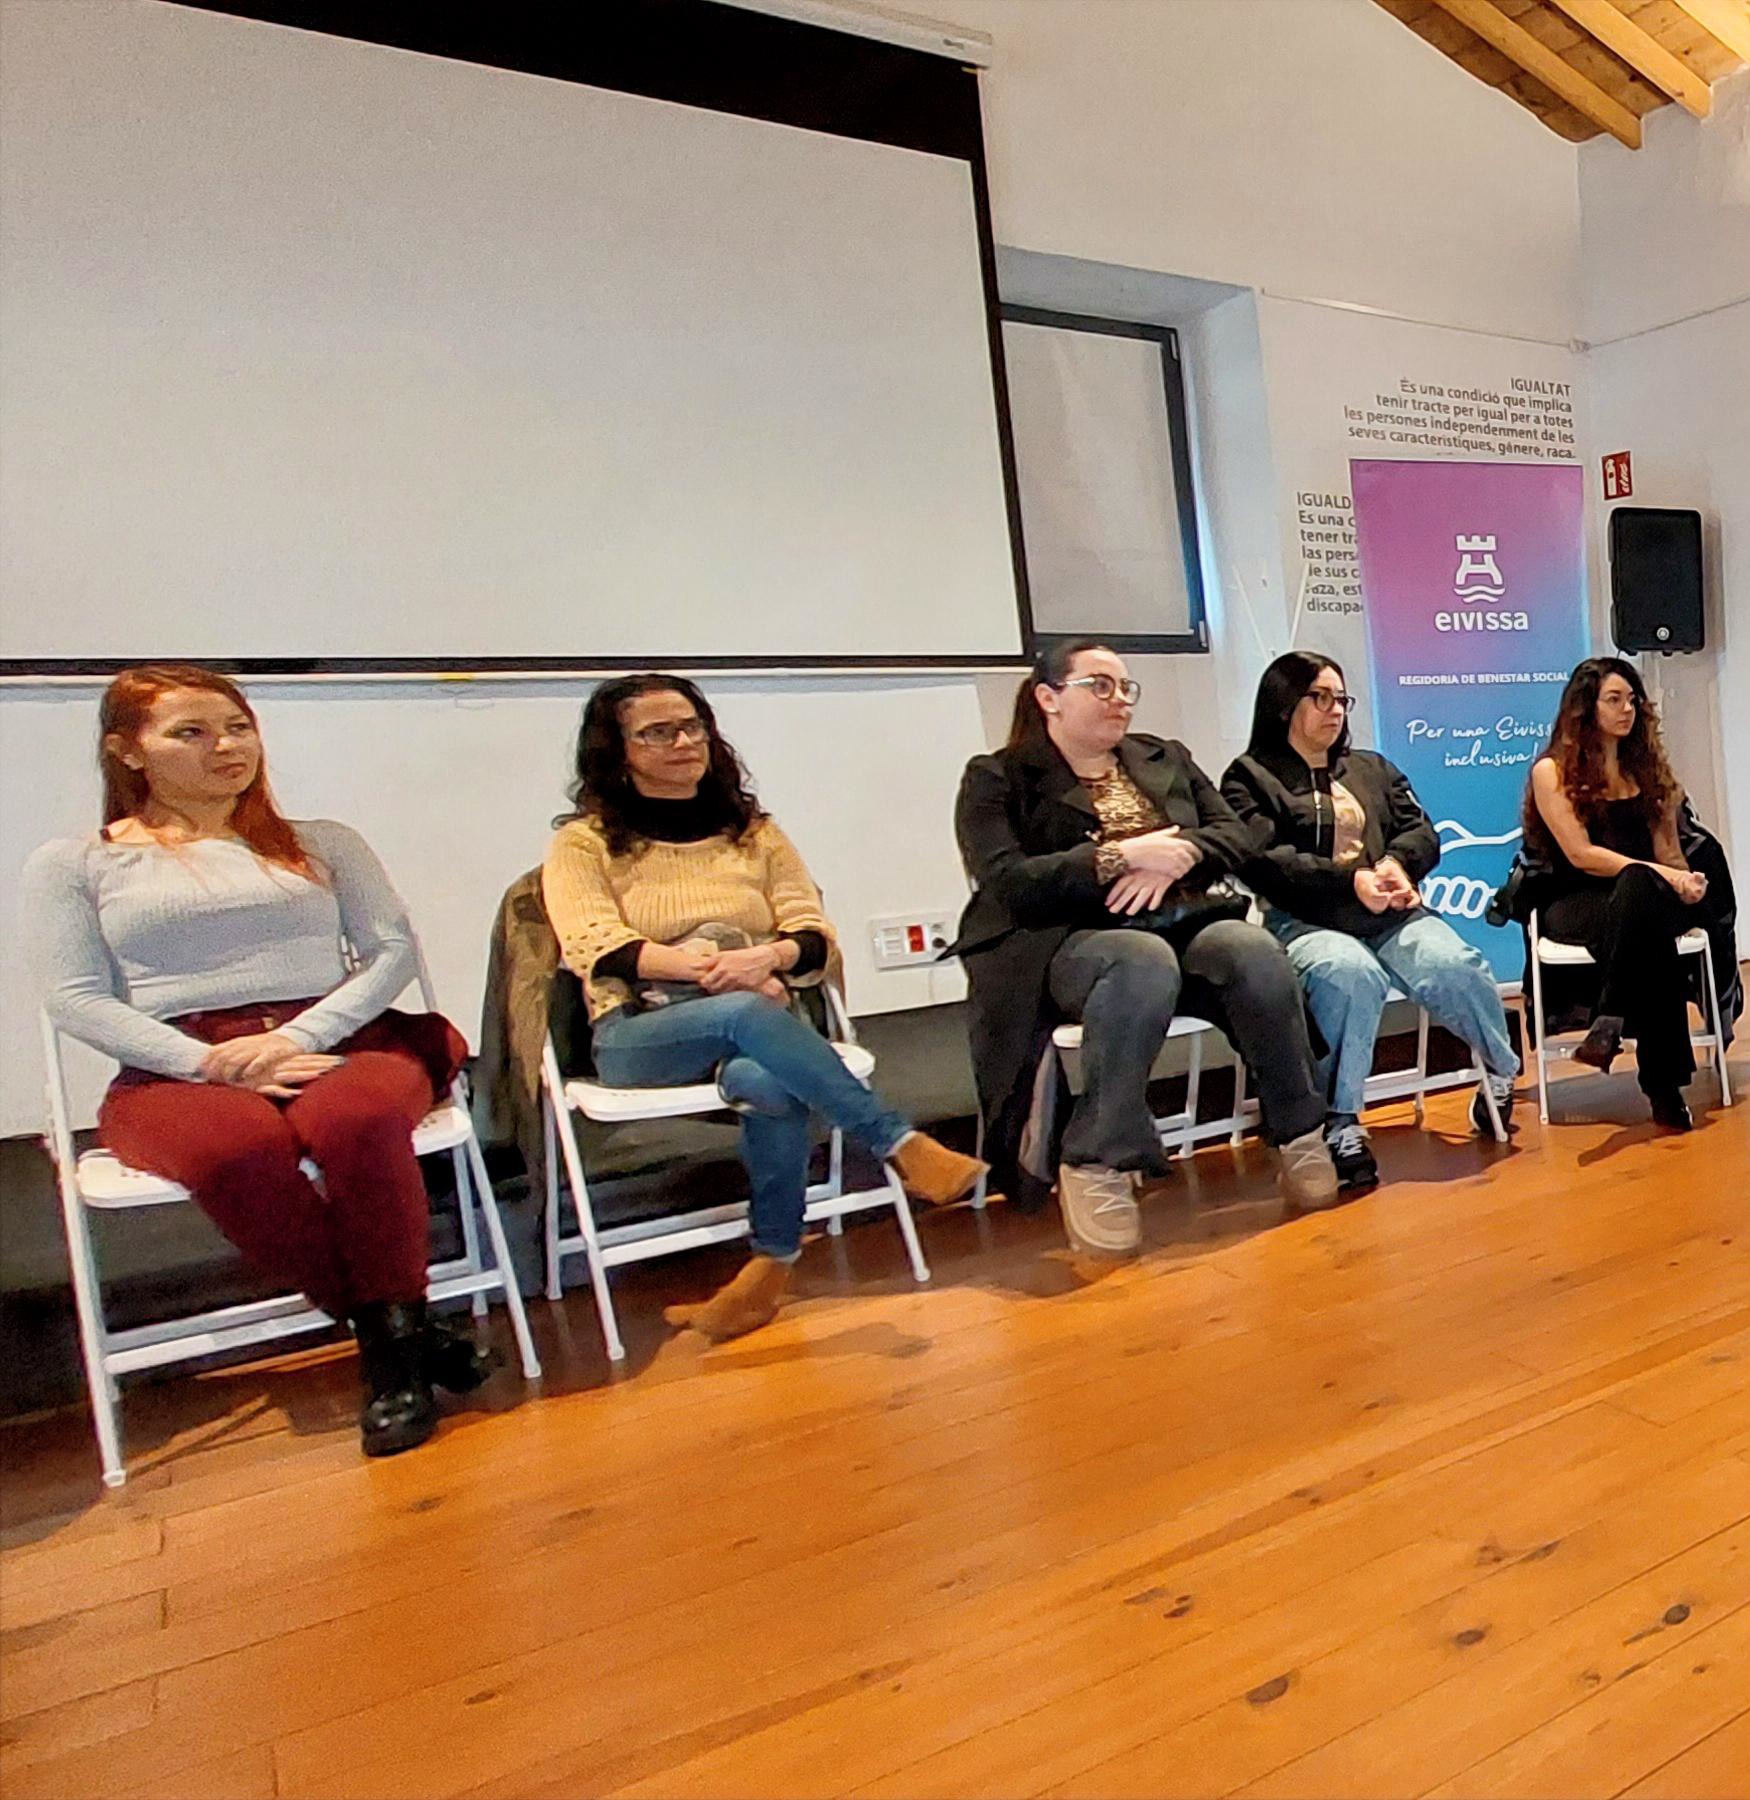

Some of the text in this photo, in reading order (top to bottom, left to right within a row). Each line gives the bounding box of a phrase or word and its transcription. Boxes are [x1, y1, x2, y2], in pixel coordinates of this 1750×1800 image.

[1510, 377, 1570, 396] IGUALTAT
[1419, 384, 1444, 396] una
[1447, 388, 1500, 404] condició
[1503, 396, 1526, 408] que
[1528, 396, 1572, 413] implica
[1376, 394, 1573, 428] tenir tracte per igual per a totes
[1343, 405, 1363, 420] les
[1366, 411, 1428, 428] persones
[1541, 429, 1555, 441] de
[1558, 430, 1575, 443] les
[1348, 426, 1386, 440] seves
[1297, 491, 1351, 509] IGUALD
[1298, 510, 1314, 524] Es
[1318, 514, 1344, 526] una
[1300, 529, 1338, 543] tener
[1302, 545, 1321, 559] las
[1325, 566, 1348, 578] sus
[1307, 597, 1364, 616] discapa
[1435, 611, 1529, 632] eivissa
[1399, 671, 1569, 686] REGIDORIA DE BENESTAR SOCIAL
[1406, 719, 1445, 744] Per
[1452, 726, 1490, 738] una
